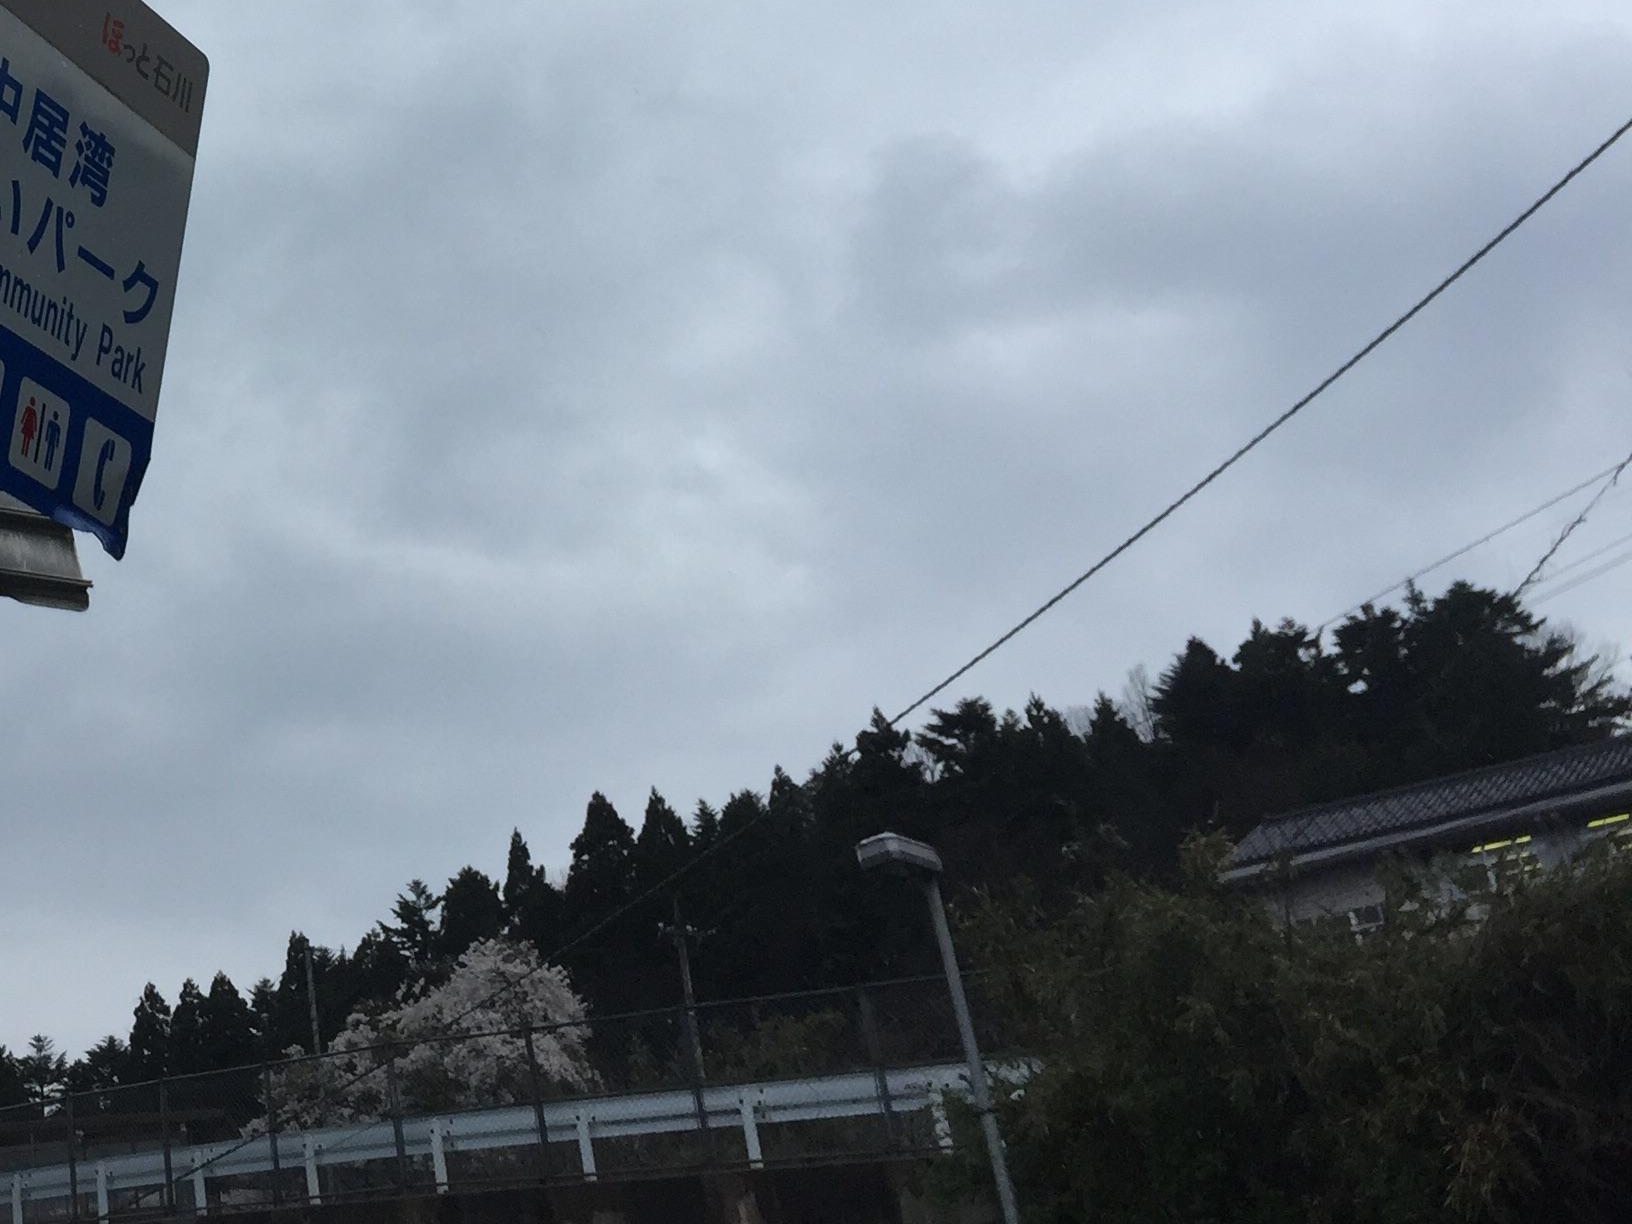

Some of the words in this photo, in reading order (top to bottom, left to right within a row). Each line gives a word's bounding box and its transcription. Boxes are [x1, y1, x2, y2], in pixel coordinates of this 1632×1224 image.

[102, 11, 193, 113] ほっと石川
[96, 323, 146, 394] Park
